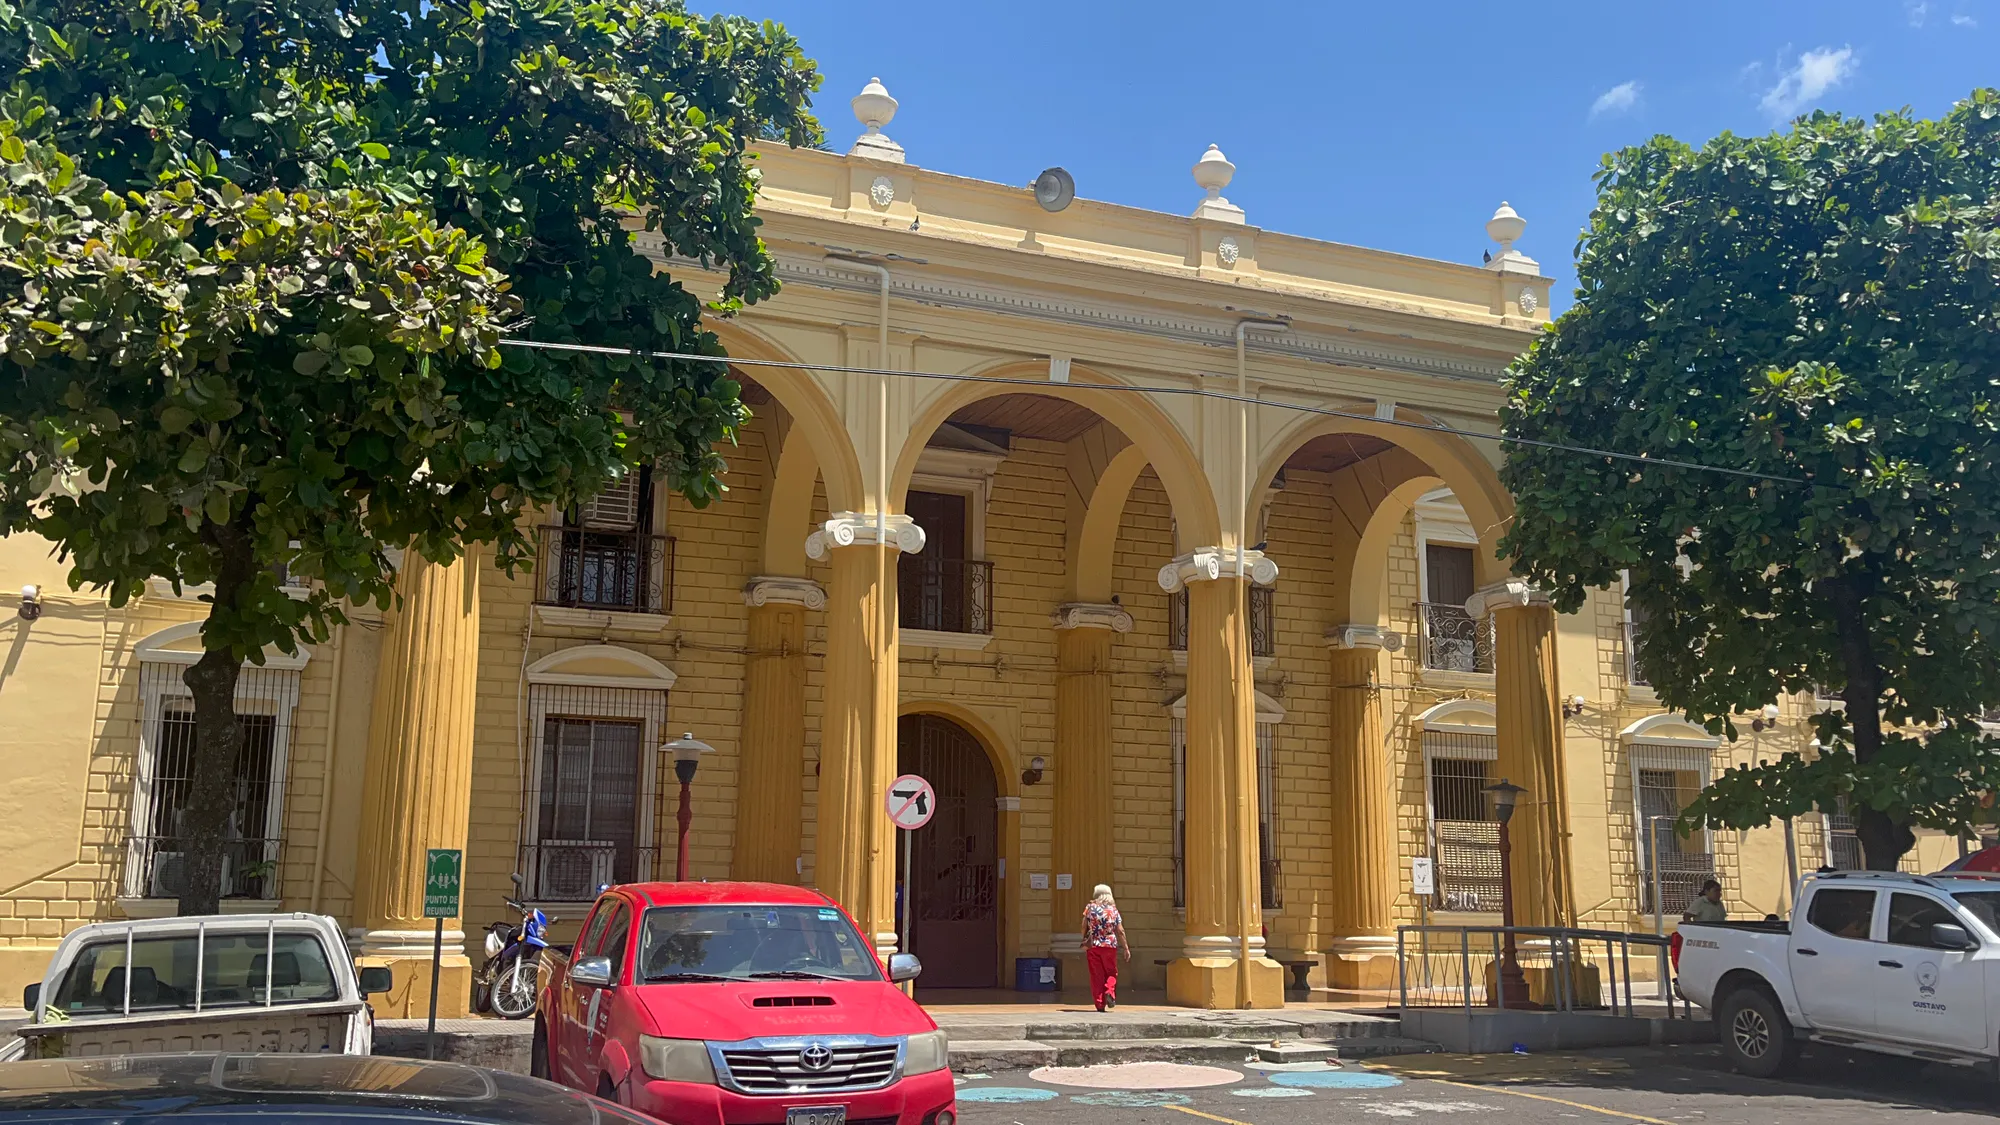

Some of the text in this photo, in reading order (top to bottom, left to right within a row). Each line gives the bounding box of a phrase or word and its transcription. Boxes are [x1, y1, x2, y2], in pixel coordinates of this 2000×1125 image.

[425, 895, 458, 904] PUNTO DE
[426, 905, 456, 915] REUNIÓN
[1686, 939, 1720, 949] DIESEL
[1912, 1001, 1946, 1011] GUSTAVO
